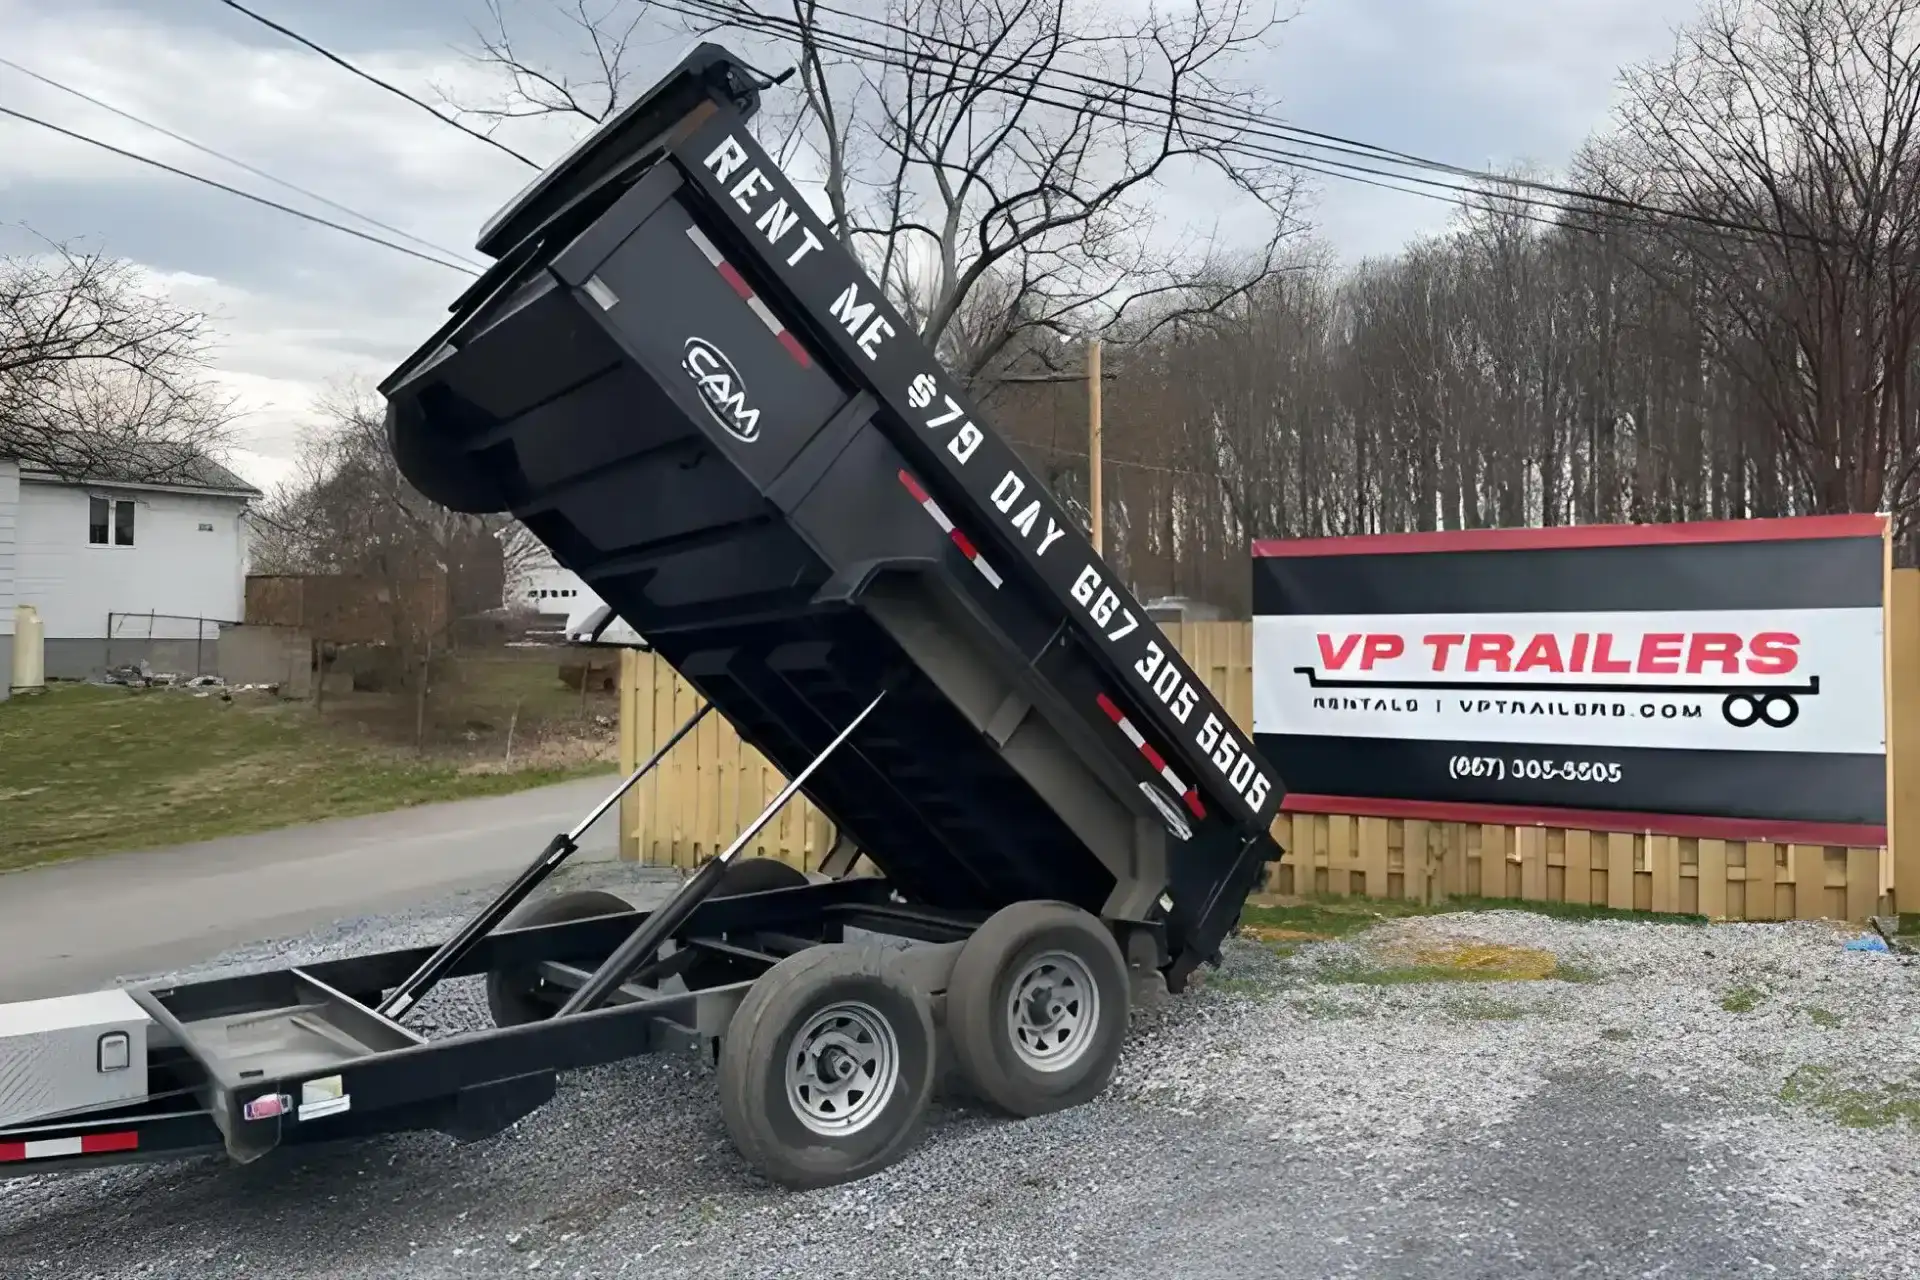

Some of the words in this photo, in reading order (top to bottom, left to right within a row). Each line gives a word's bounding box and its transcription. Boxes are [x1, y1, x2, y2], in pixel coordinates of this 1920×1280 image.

[688, 346, 760, 436] CAM
[703, 134, 824, 266] RENT
[829, 282, 895, 360] ME
[908, 373, 984, 465] $79
[990, 470, 1066, 556] DAY
[1070, 564, 1139, 642] 667
[1134, 640, 1200, 724] 305
[1195, 711, 1272, 814] 5505
[1316, 633, 1404, 671] VP
[1423, 631, 1801, 675] TRAILERS
